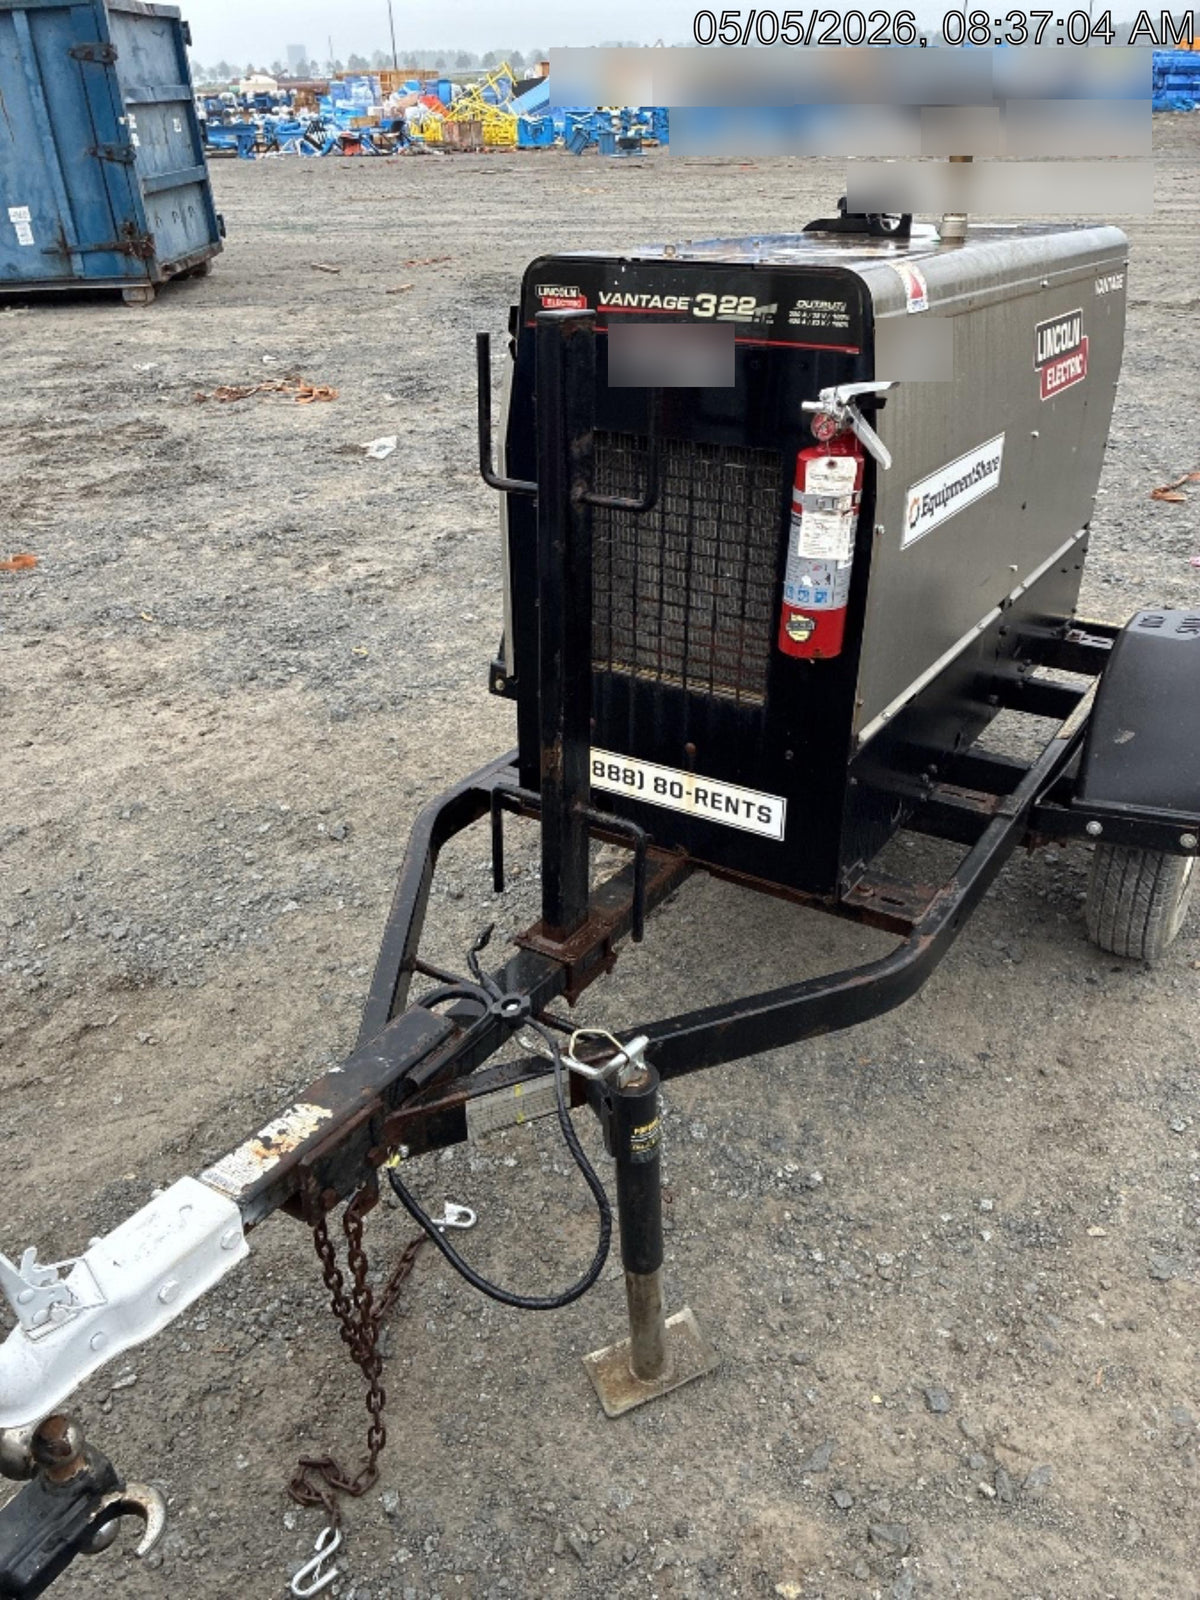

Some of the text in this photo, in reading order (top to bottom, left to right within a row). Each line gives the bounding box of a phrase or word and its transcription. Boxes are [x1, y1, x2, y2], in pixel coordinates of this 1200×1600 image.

[598, 291, 757, 317] VANTAGE 322
[1037, 318, 1081, 362] LINCOLN
[1046, 353, 1084, 390] ELECTRIC
[653, 776, 773, 824] 80-RENTS
